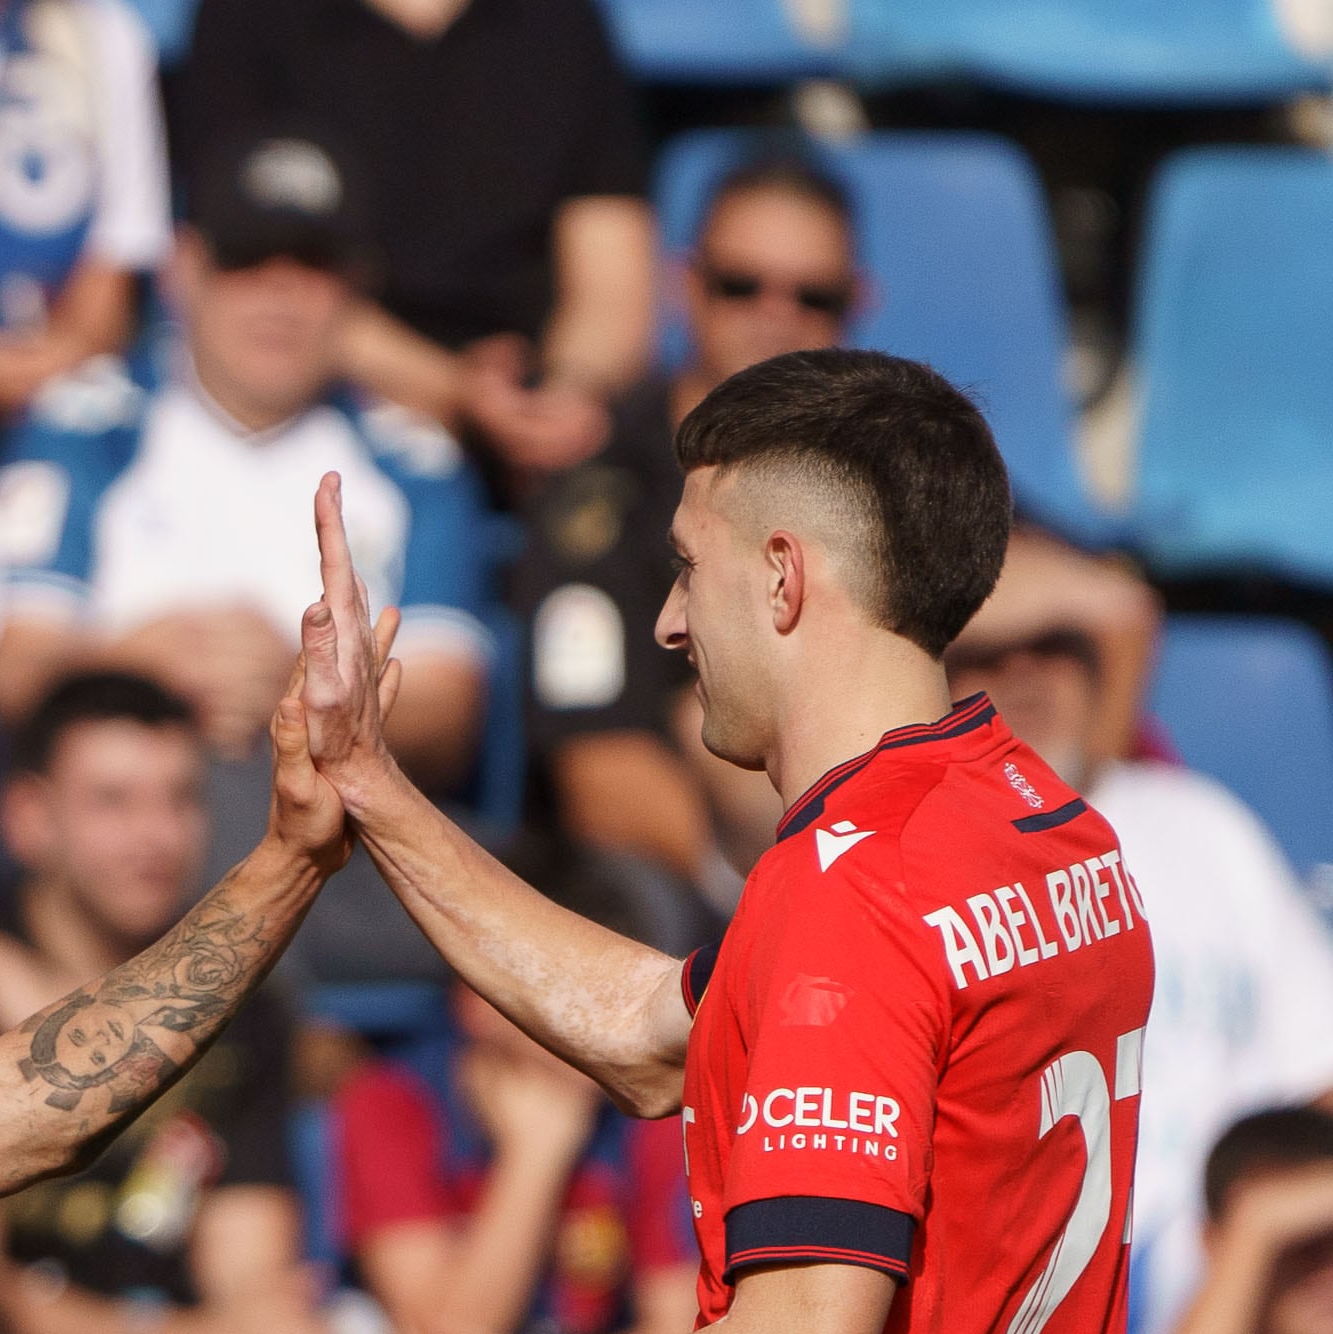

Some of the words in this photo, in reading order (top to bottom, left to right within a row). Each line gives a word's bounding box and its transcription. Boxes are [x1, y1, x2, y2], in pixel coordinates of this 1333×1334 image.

[922, 881, 1059, 990] ABEL
[761, 1086, 902, 1139] CELER
[764, 1133, 898, 1162] LIGHTING
